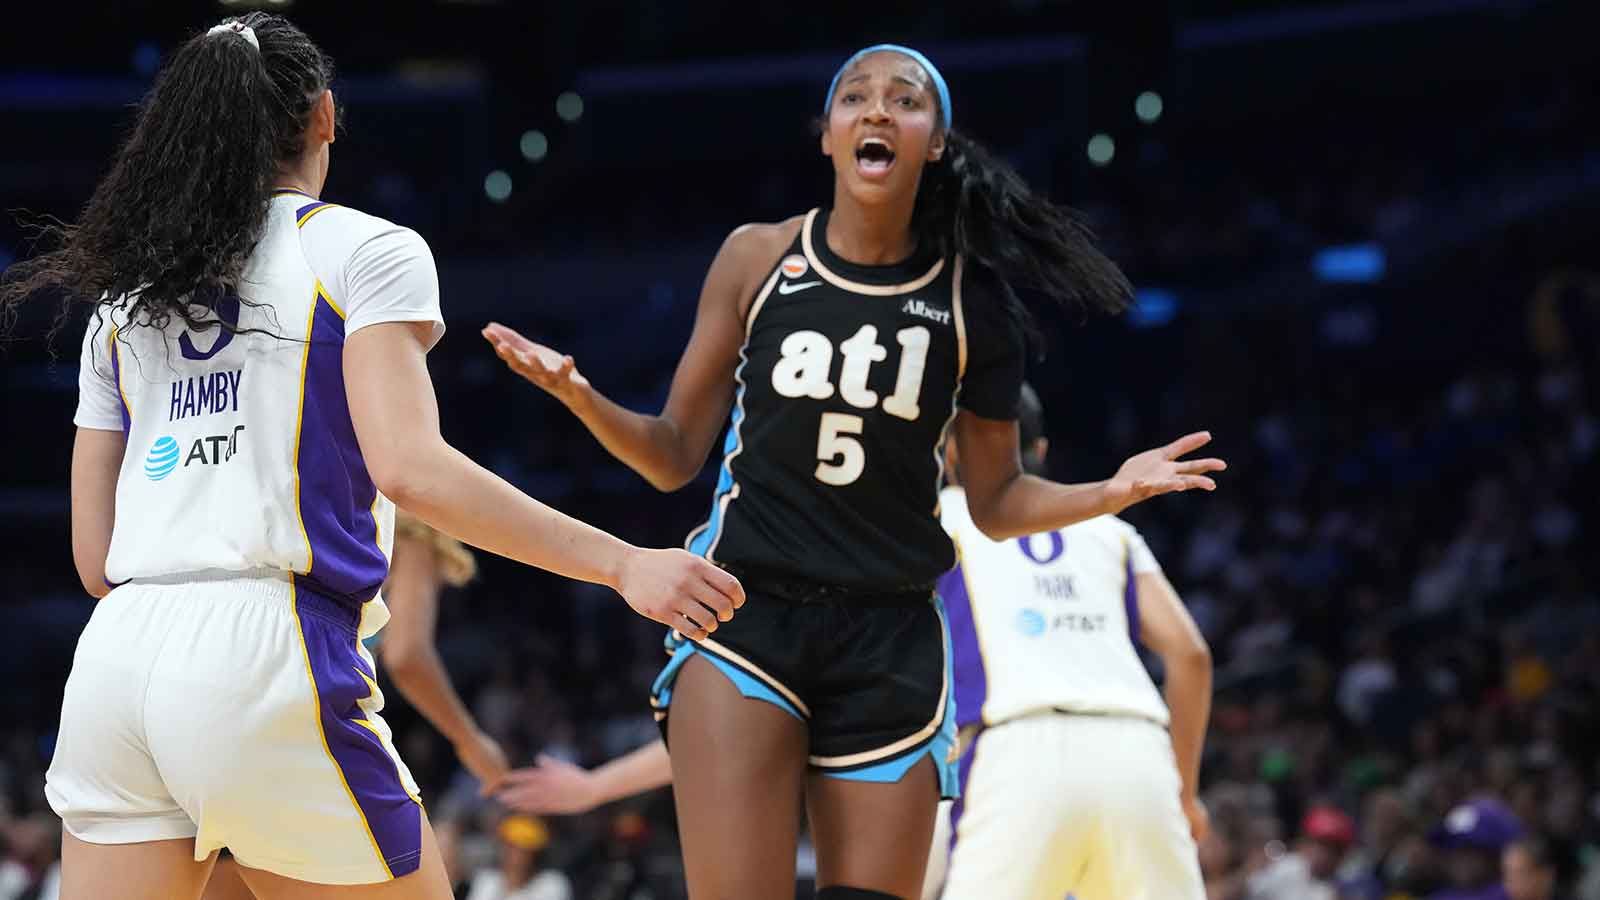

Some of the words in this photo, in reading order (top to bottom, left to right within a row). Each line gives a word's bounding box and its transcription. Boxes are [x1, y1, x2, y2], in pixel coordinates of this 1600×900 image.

[902, 299, 950, 325] Albert
[169, 369, 242, 421] HAMBY
[771, 324, 931, 421] atl
[814, 411, 865, 486] 5
